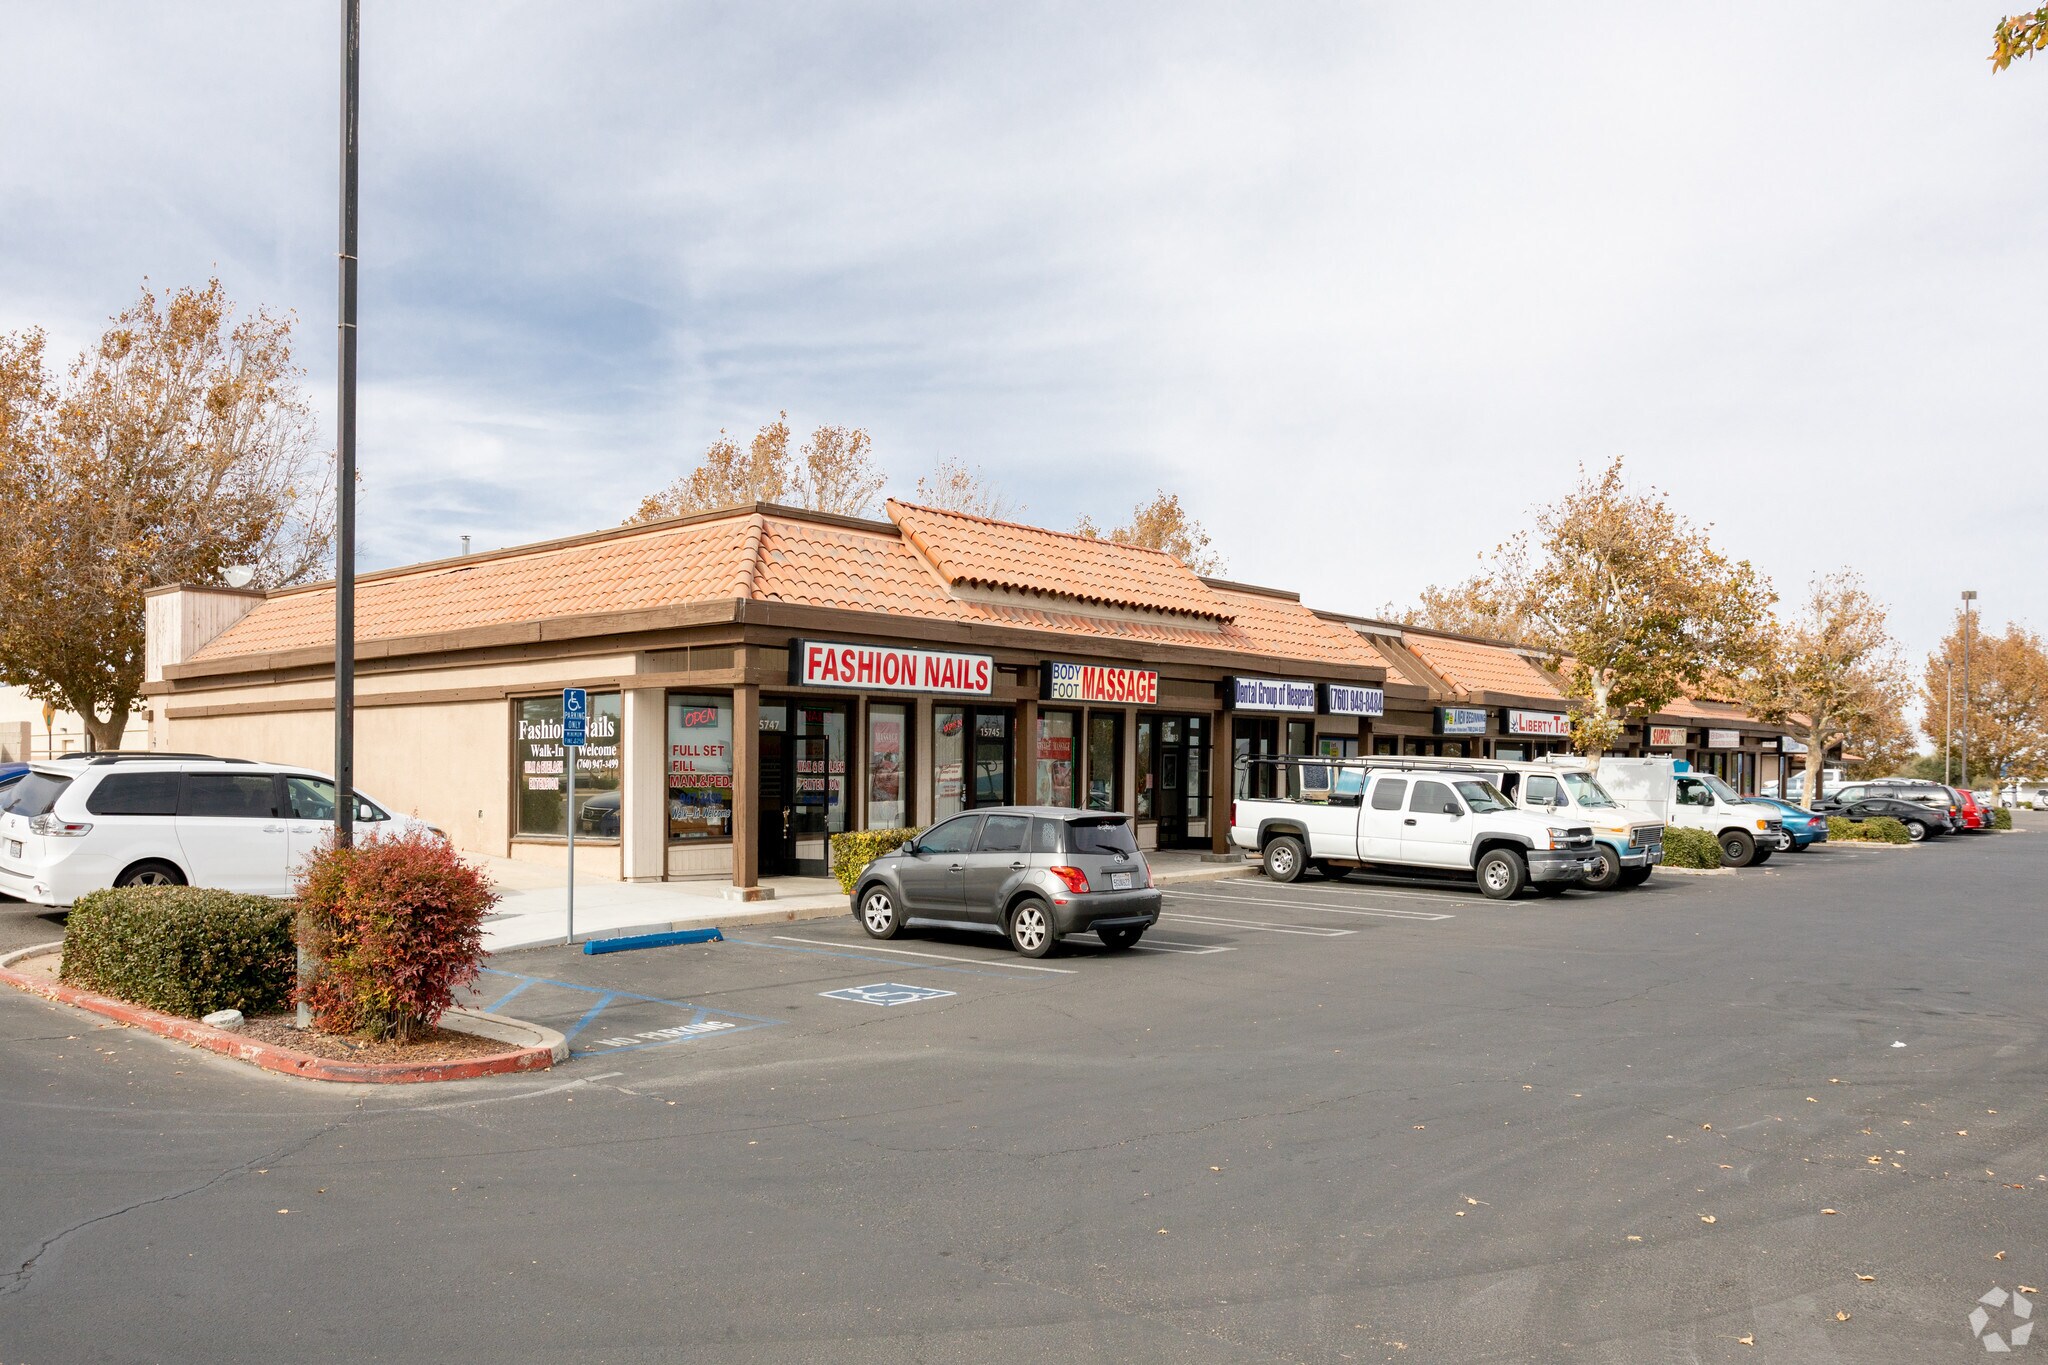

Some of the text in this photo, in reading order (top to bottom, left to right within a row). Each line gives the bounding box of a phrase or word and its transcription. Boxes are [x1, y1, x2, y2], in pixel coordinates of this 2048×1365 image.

[808, 647, 988, 691] FASHION NAILS
[1053, 664, 1081, 680] BODY
[1052, 683, 1079, 698] FOOT
[1082, 667, 1156, 703] MASSAGE
[1235, 680, 1313, 709] Dental Group of Hesperia
[1331, 688, 1349, 711] (760)
[685, 708, 716, 727] OPEN
[1519, 713, 1552, 732] LIBERTY
[980, 728, 1000, 737] 15745
[1653, 728, 1685, 745] SUPERCUTS
[531, 743, 617, 757] Walk-In Welcome
[672, 745, 725, 756] FULL SET
[577, 759, 592, 770] (760)
[672, 760, 696, 772] FILL
[812, 761, 818, 773] &
[594, 1021, 736, 1047] NO PARKING
